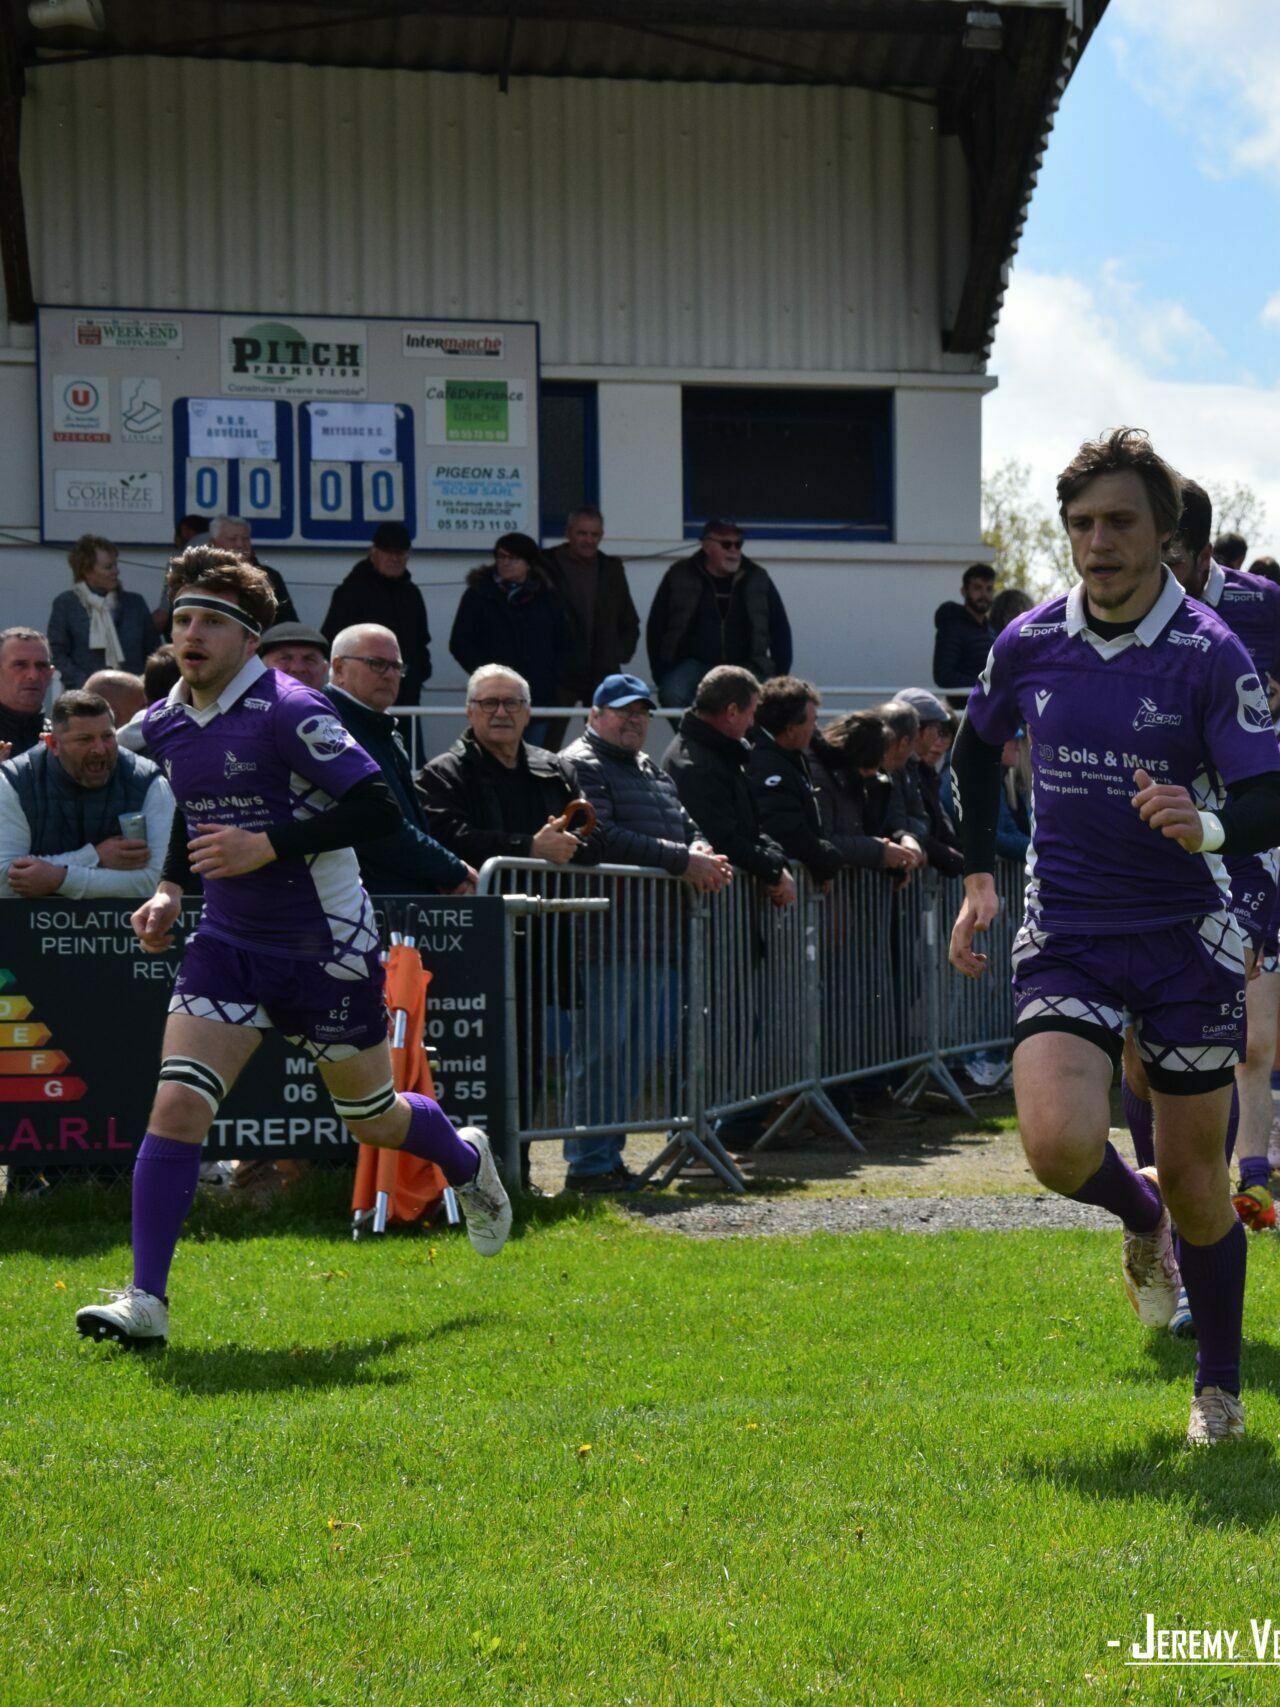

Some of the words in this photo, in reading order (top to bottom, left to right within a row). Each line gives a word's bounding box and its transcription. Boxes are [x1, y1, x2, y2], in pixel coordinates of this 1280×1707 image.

[103, 325, 178, 340] WEEK-END
[232, 337, 360, 373] PITCH
[254, 366, 360, 377] PROMOTION
[228, 384, 276, 393] Construire
[435, 466, 493, 479] PIGEON
[196, 467, 218, 509] 0
[250, 467, 271, 509] 0
[320, 470, 342, 512] 0
[372, 470, 394, 512] 0
[438, 520, 452, 530] 05
[455, 520, 469, 530] 55
[472, 520, 485, 530] 73
[490, 520, 500, 530] 11
[504, 520, 518, 530] 03
[1144, 712, 1182, 726] RCPM
[1057, 745, 1099, 765] Sols
[1104, 750, 1118, 767] &
[1122, 752, 1169, 772] Murs
[1081, 770, 1124, 783] Peintures
[1061, 783, 1089, 795] peints
[1233, 907, 1251, 919] BROL
[13, 1026, 29, 1044] E
[453, 1019, 484, 1038] 01
[1202, 1023, 1238, 1034] CABROL
[31, 1053, 46, 1071] F
[43, 1080, 64, 1098] G
[283, 1083, 318, 1103] 06
[454, 1081, 487, 1100] 55
